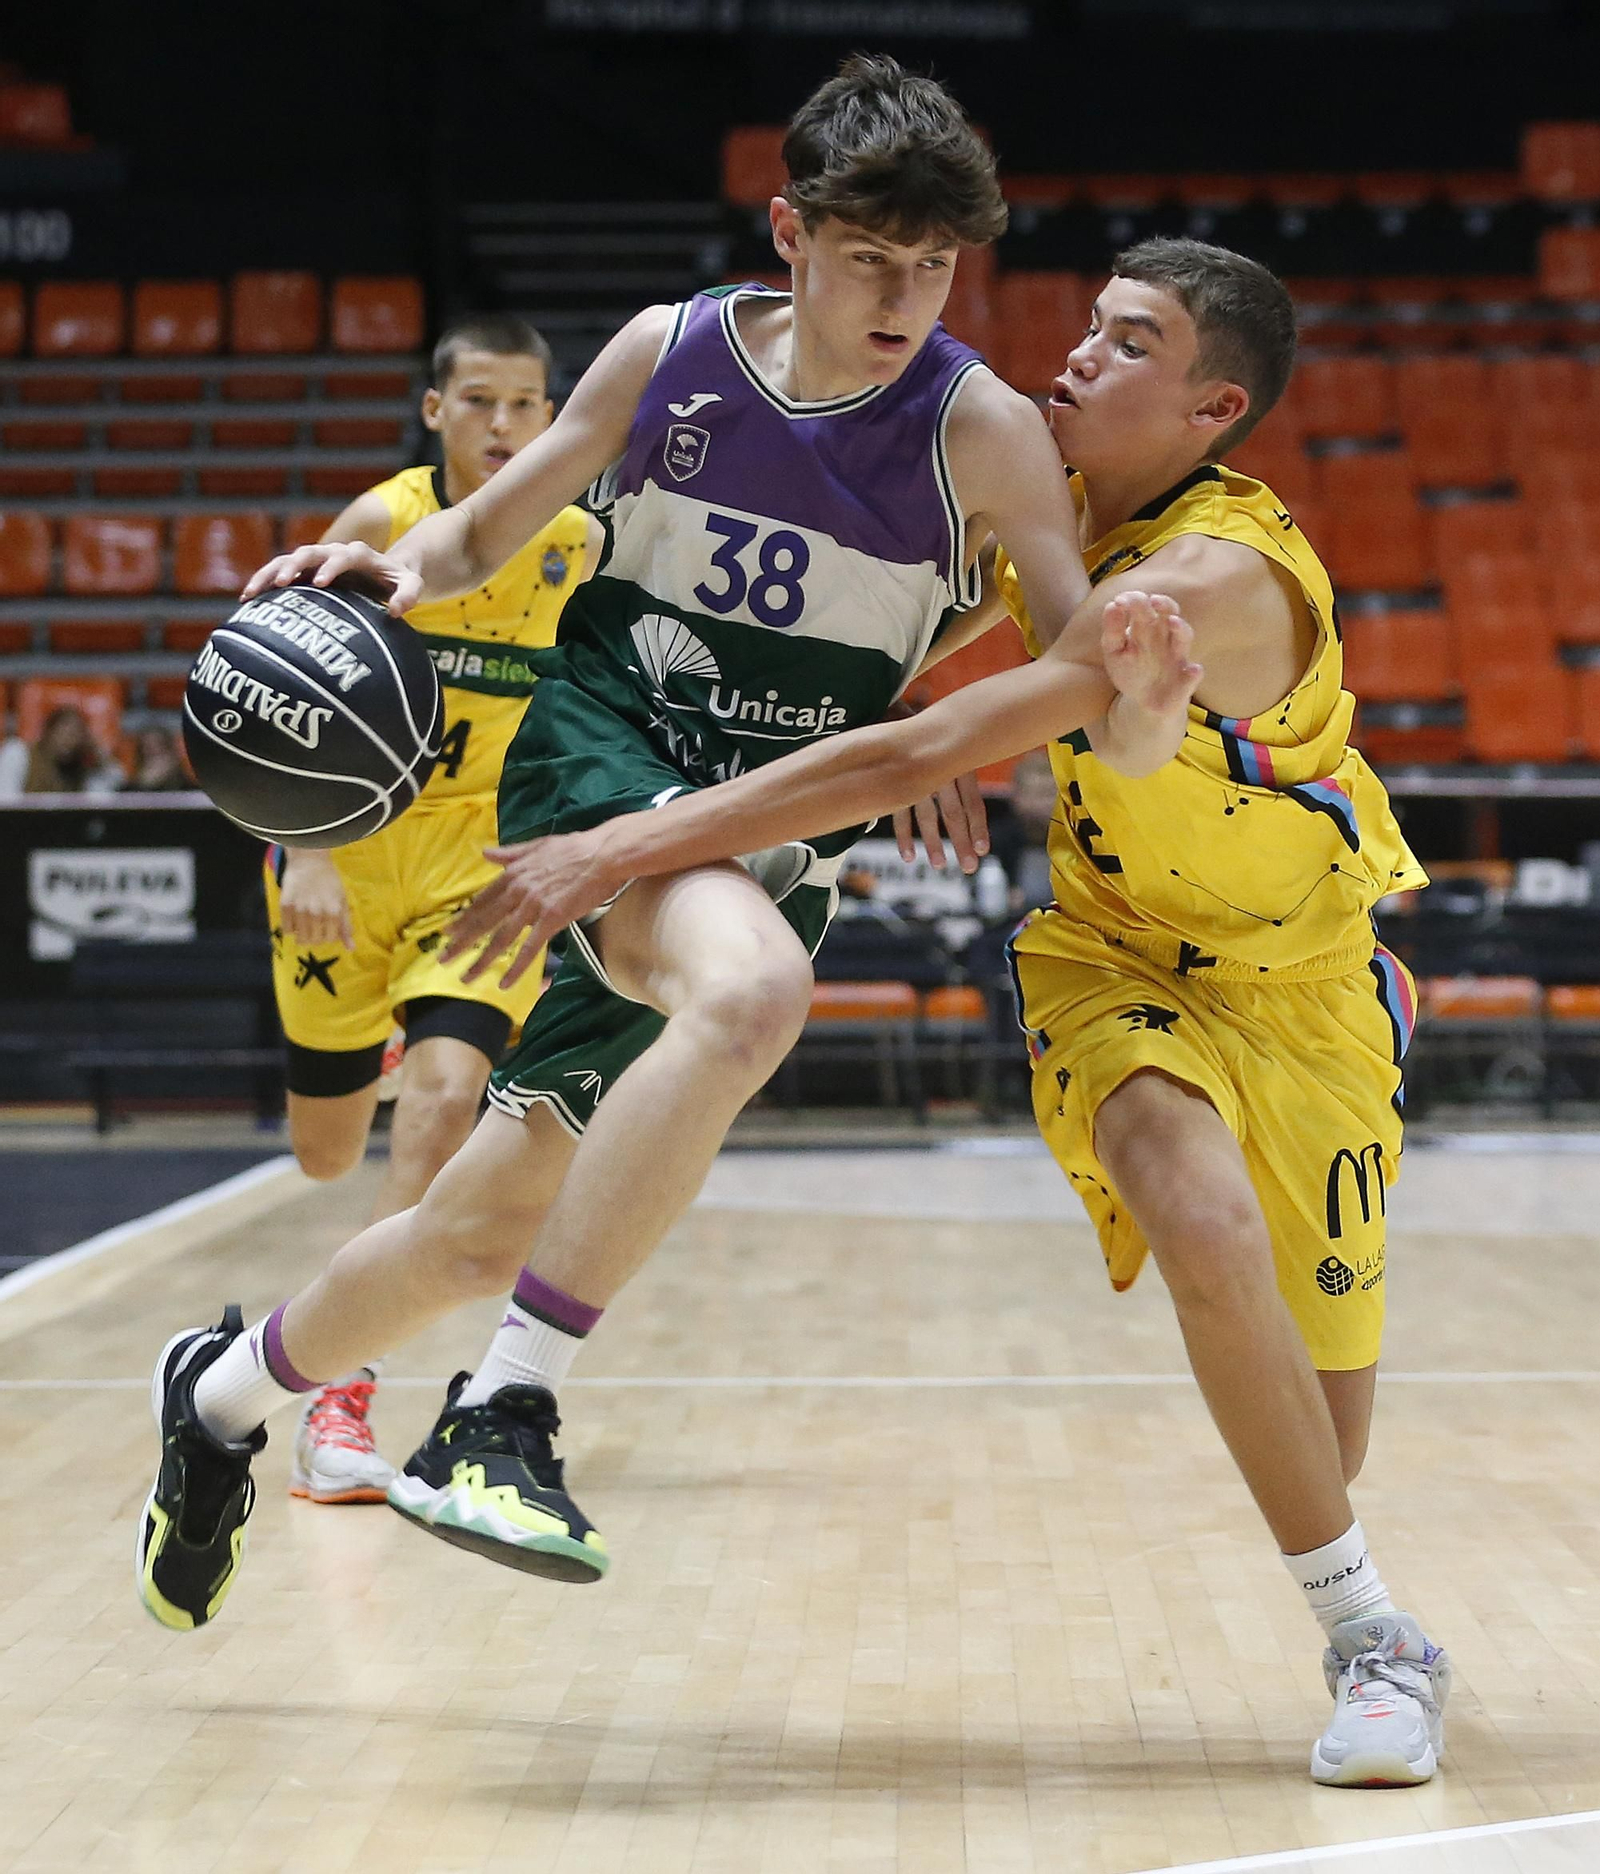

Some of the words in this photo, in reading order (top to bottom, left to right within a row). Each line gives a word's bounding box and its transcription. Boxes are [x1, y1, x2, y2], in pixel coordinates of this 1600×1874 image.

[693, 511, 810, 628] 38
[191, 643, 334, 749] SPALDING
[708, 684, 847, 734] Unicaja
